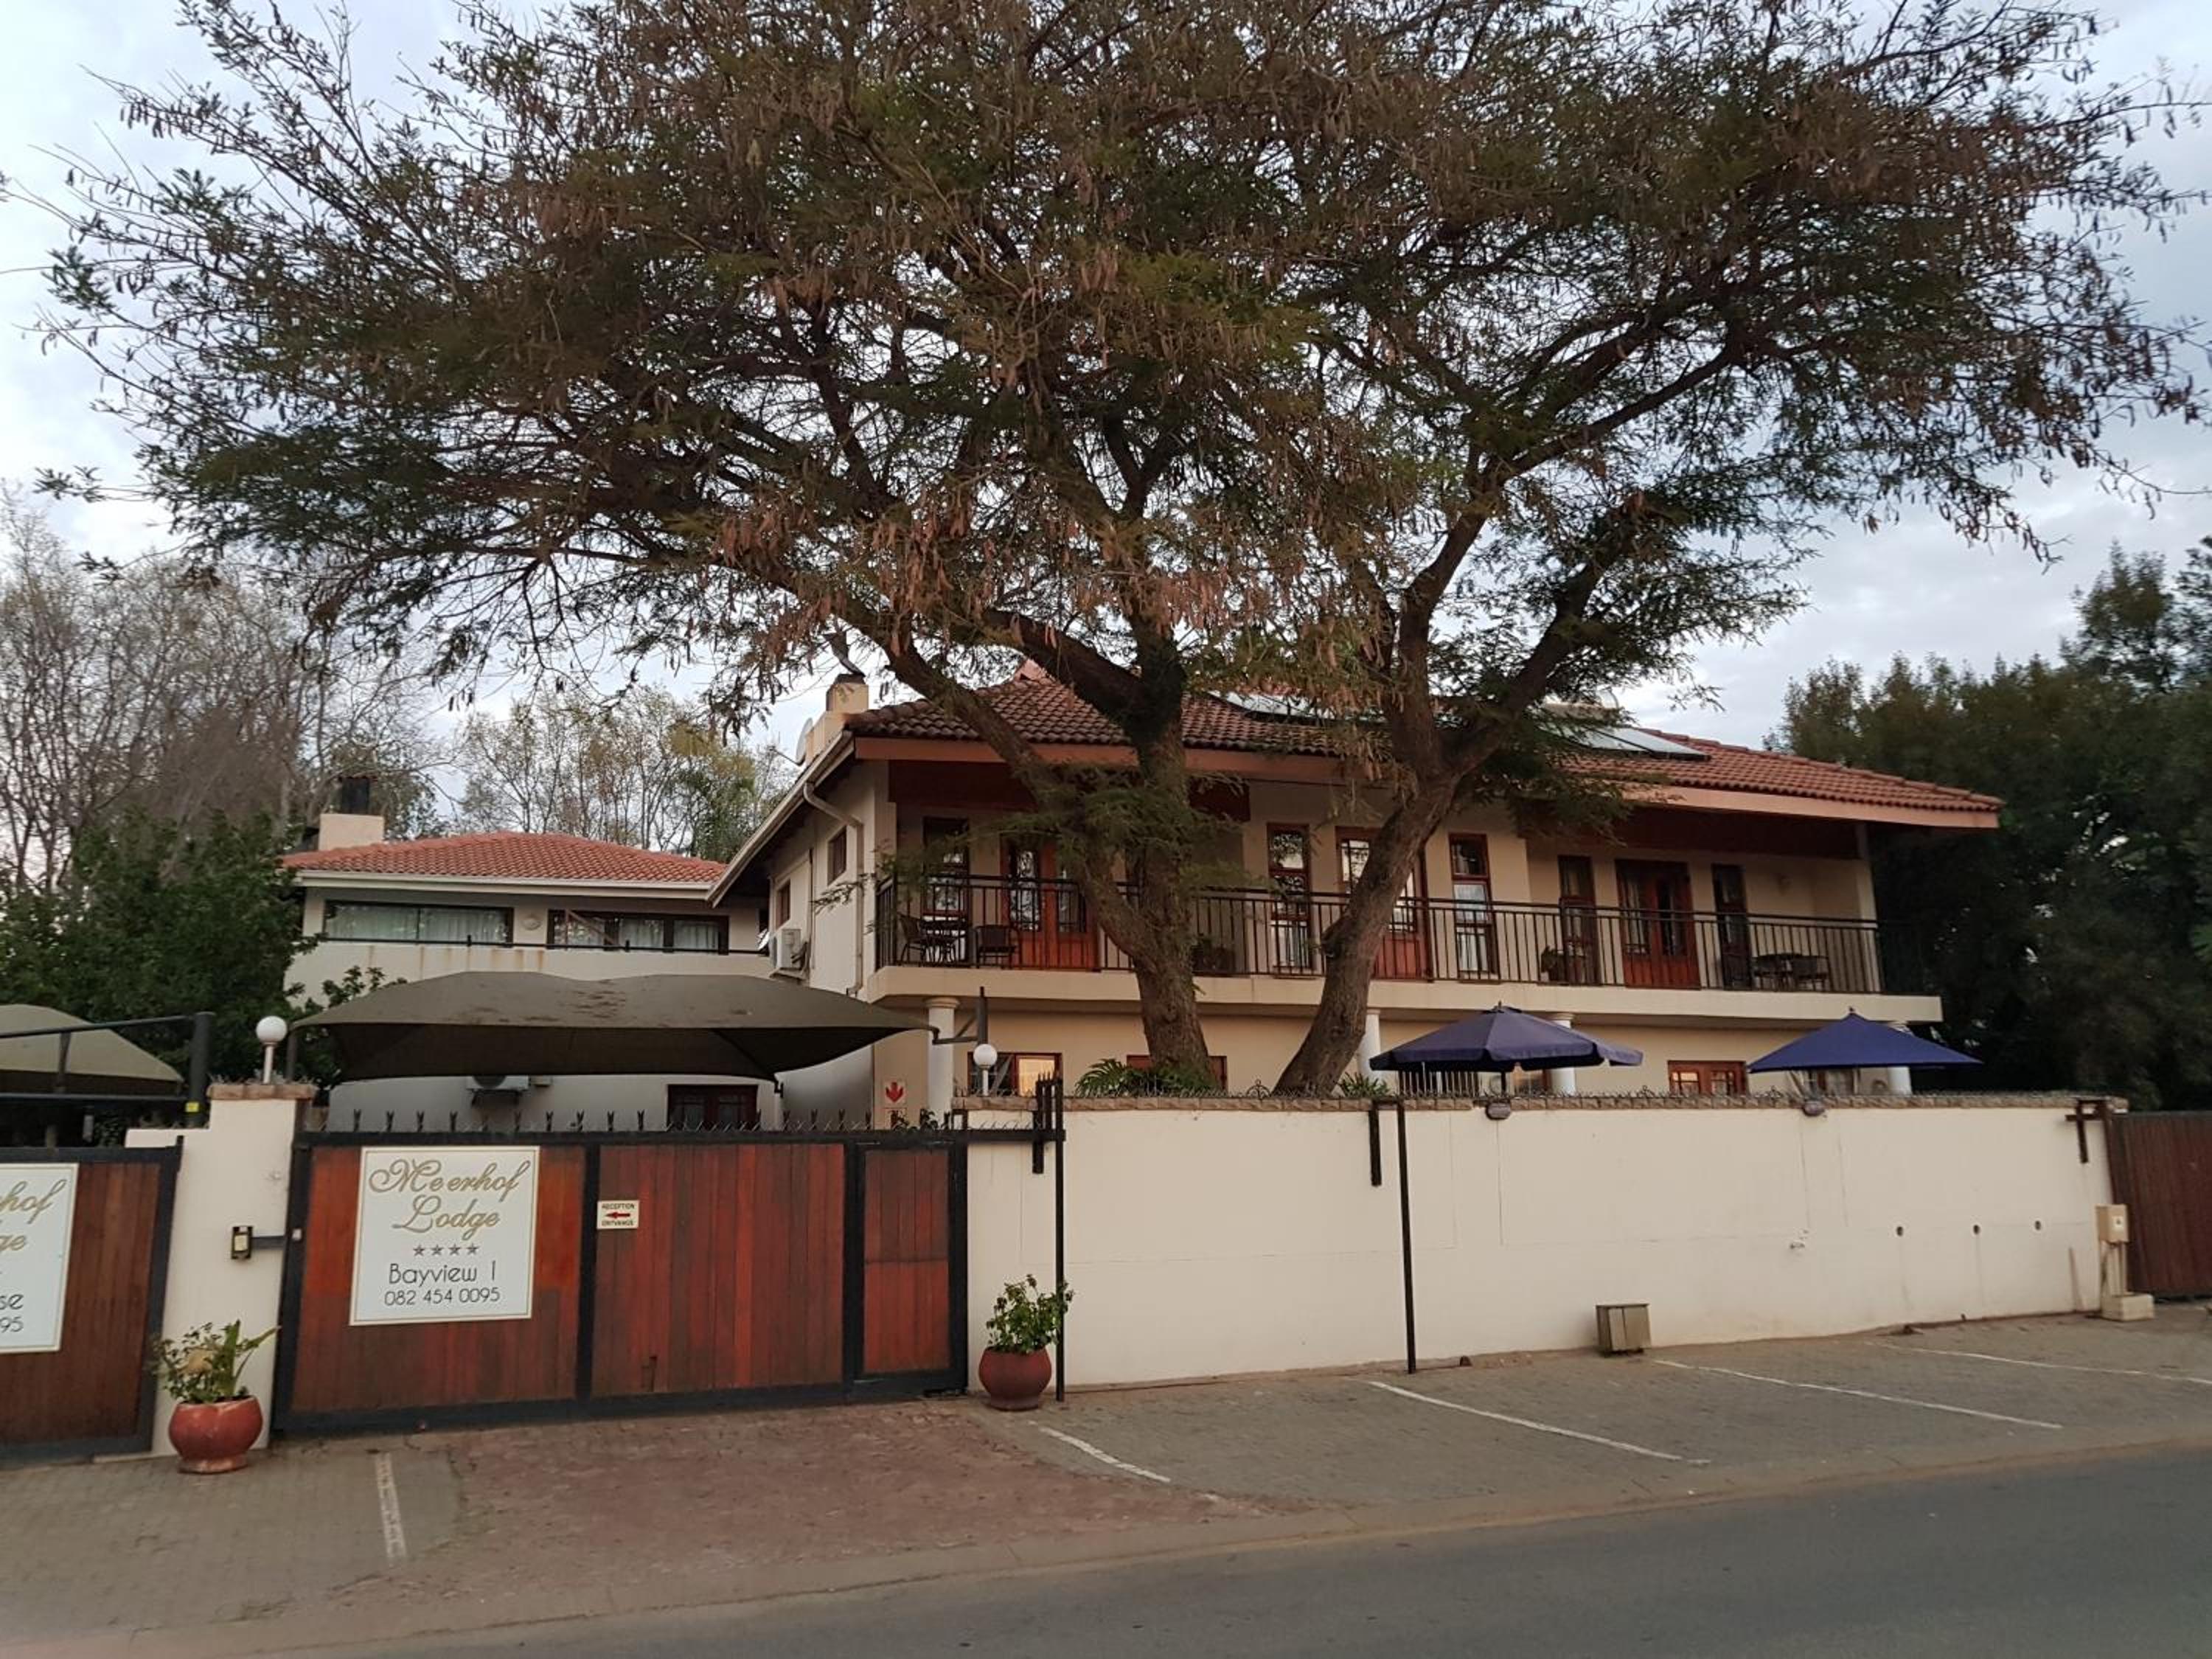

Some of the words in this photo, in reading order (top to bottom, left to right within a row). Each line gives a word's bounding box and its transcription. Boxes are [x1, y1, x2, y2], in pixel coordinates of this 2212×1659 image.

[0, 1179, 67, 1225] hof
[369, 1158, 530, 1202] Meerhof
[392, 1194, 500, 1240] Lodge
[385, 1290, 416, 1306] 082
[424, 1290, 452, 1304] 454
[459, 1287, 501, 1303] 0095
[389, 1263, 477, 1287] Bayview
